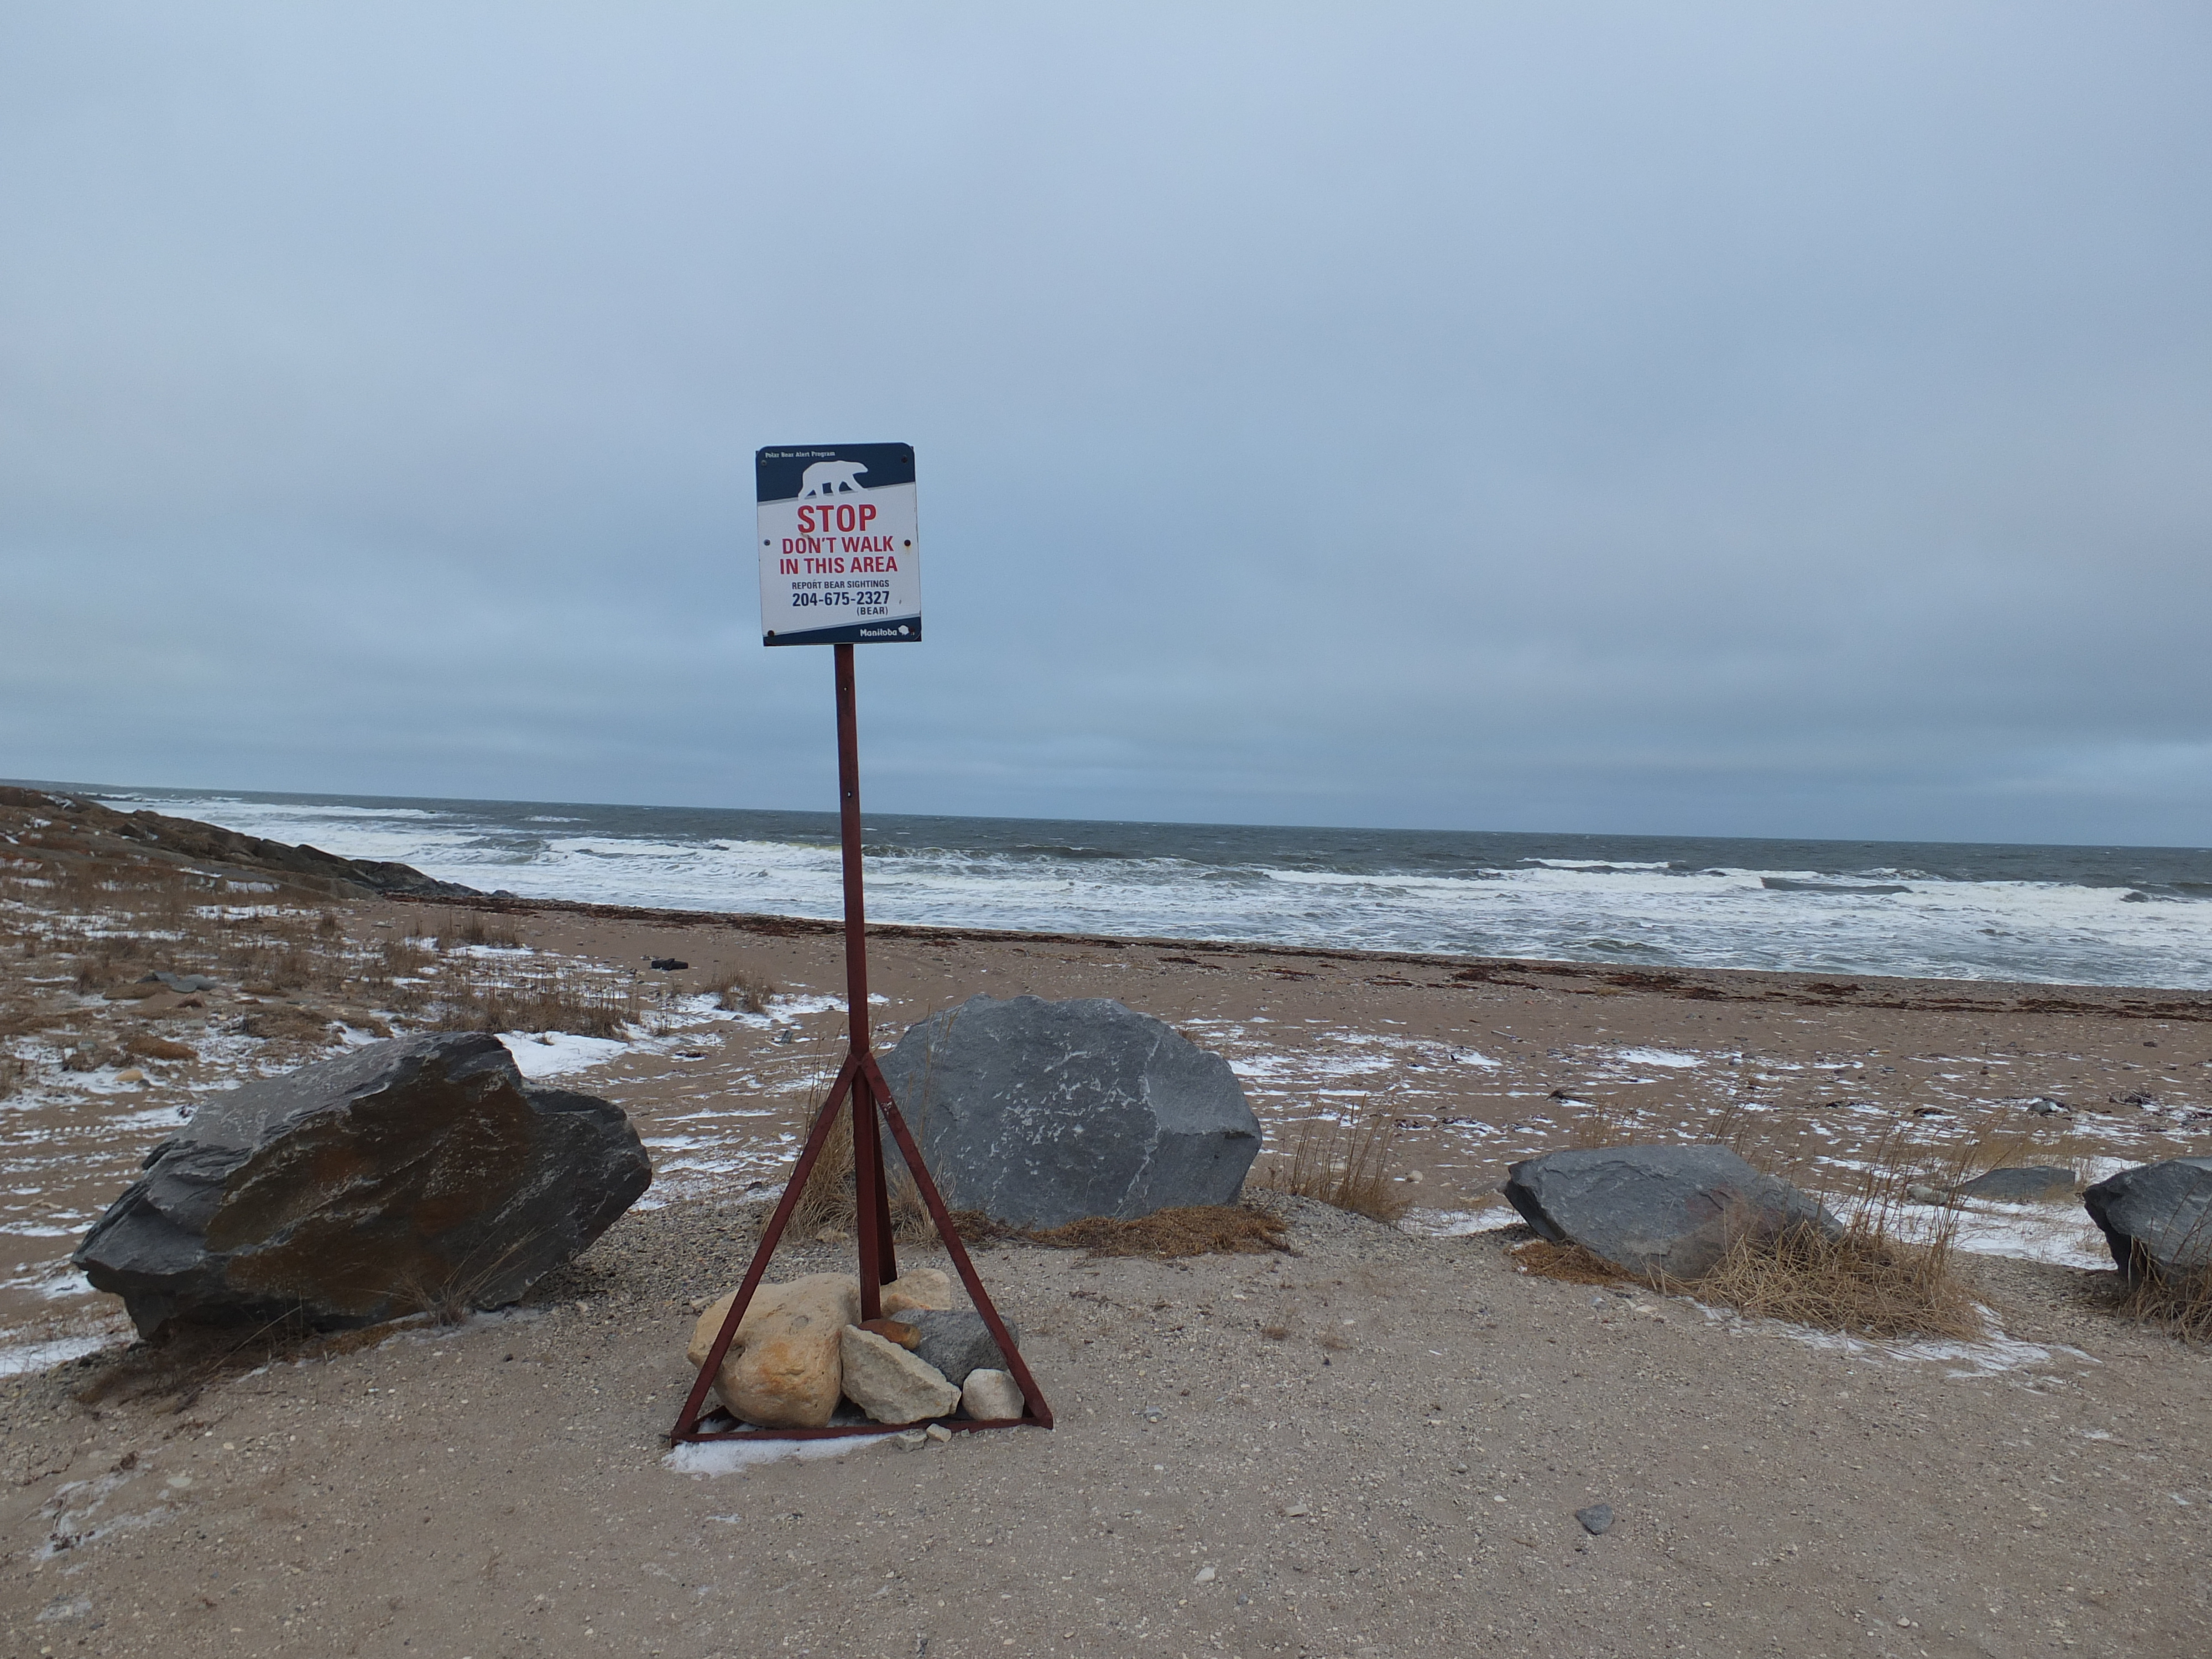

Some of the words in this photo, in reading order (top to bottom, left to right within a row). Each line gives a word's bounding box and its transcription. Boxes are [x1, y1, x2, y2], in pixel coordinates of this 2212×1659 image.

[797, 504, 877, 533] STOP
[782, 537, 837, 554] DON'T
[842, 536, 894, 553] WALK
[780, 559, 798, 575] IN
[804, 557, 844, 574] THIS
[850, 556, 898, 573] AREA
[792, 591, 889, 607] 204-675-2327
[857, 607, 889, 616] (BEAR)
